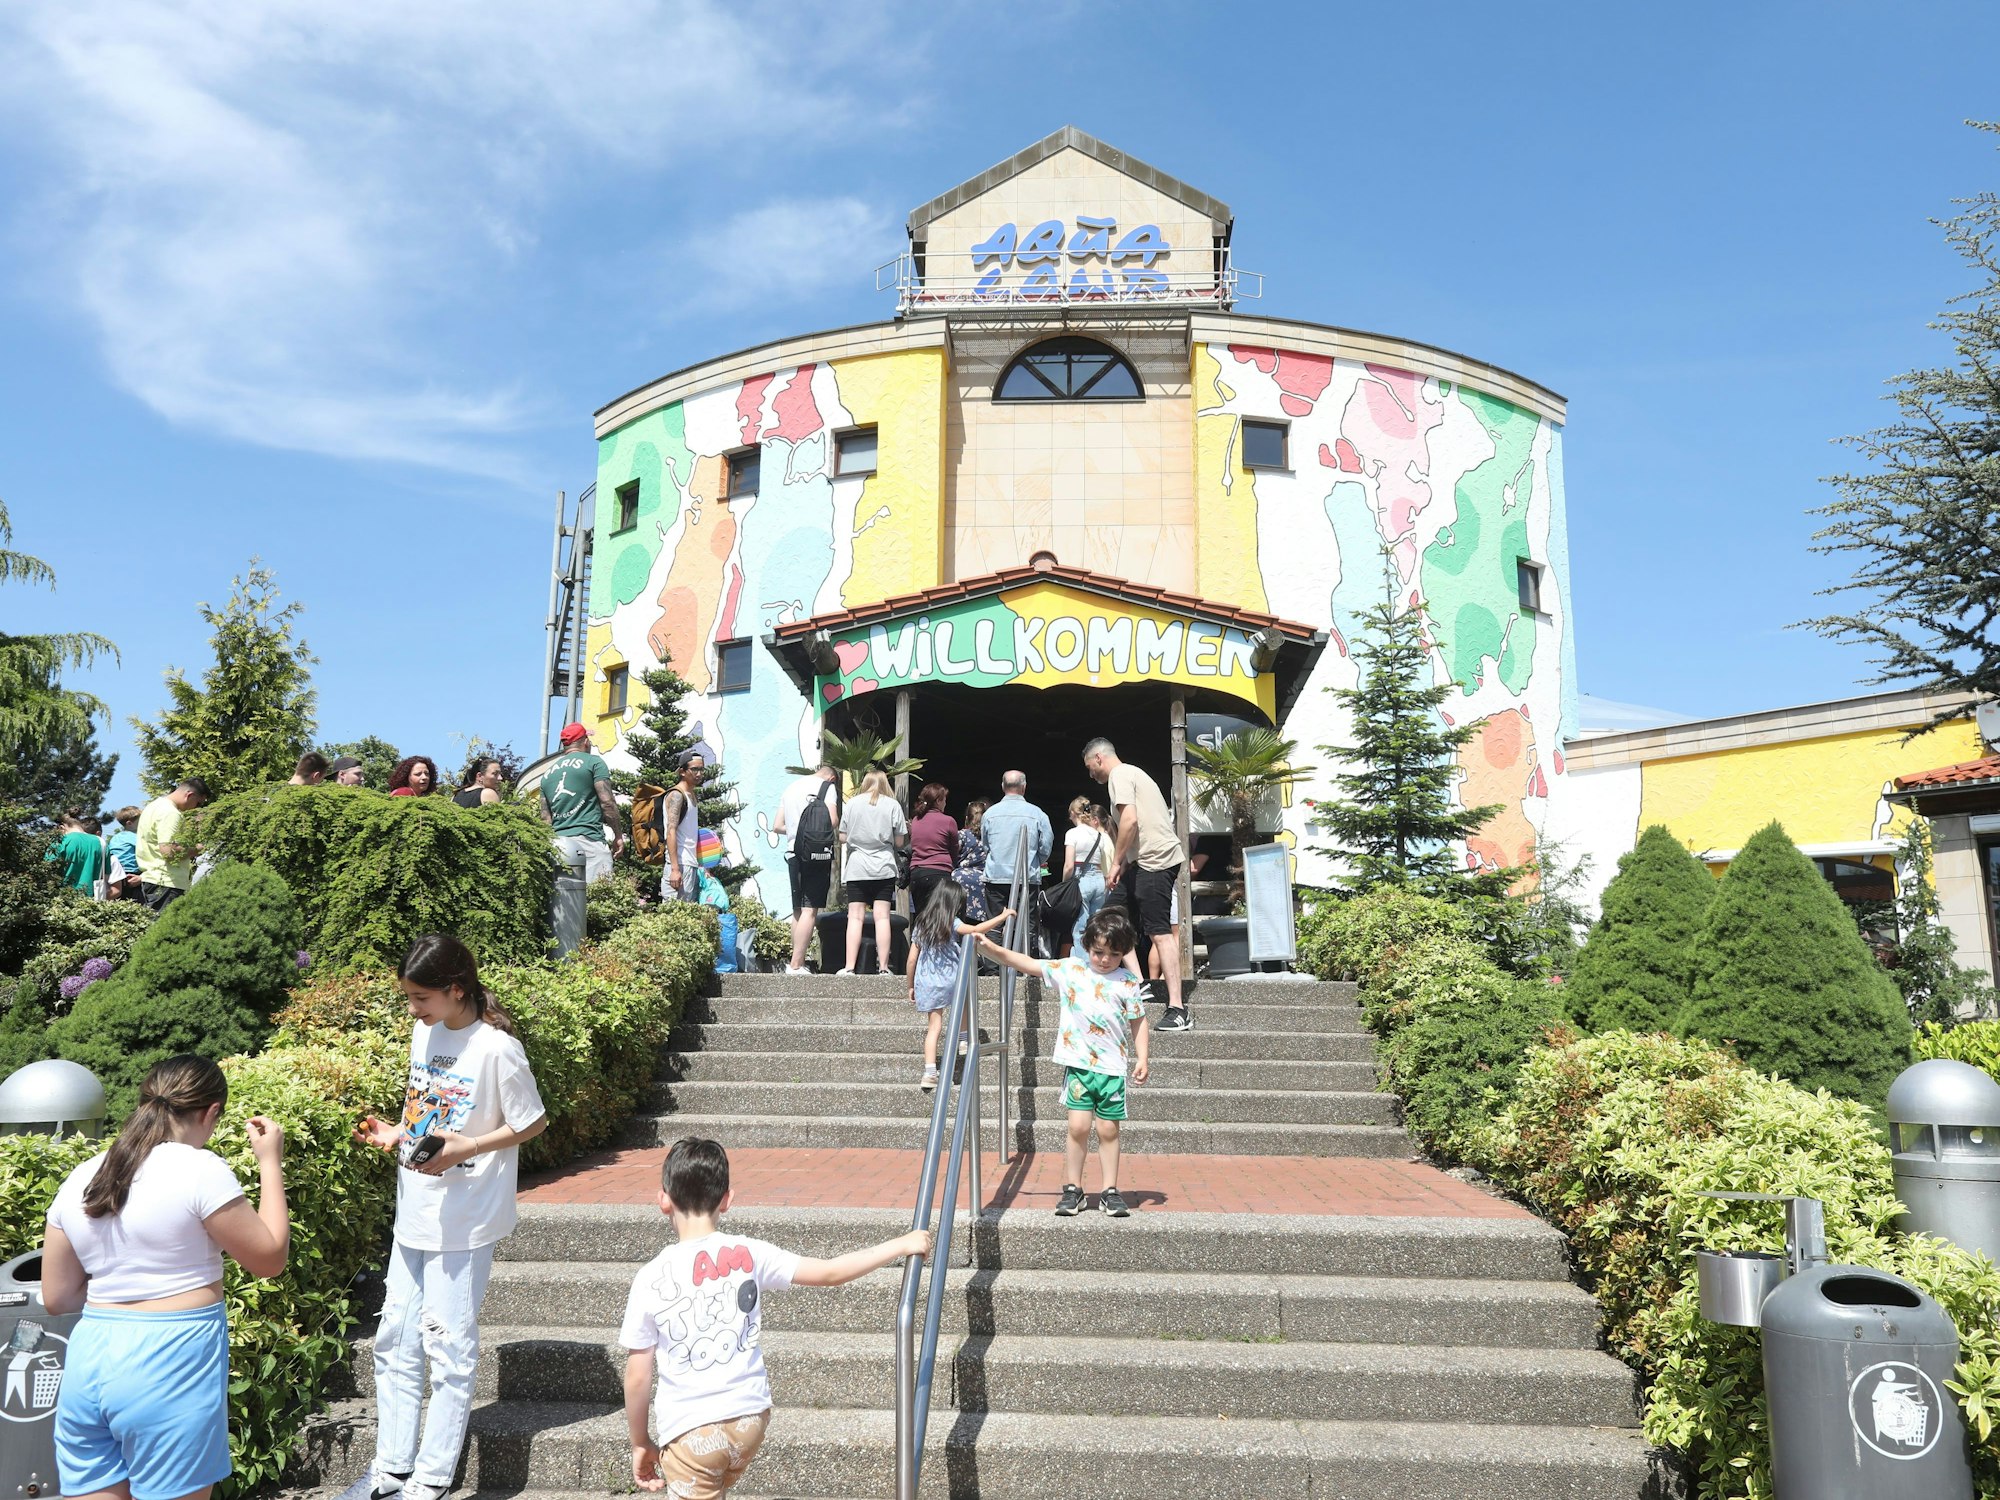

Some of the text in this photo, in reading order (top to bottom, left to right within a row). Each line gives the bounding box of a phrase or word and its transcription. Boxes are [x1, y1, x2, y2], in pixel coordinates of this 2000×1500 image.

[970, 215, 1171, 267] AQUA
[543, 757, 584, 779] PARIS
[810, 852, 831, 860] PUMA
[692, 1244, 754, 1287] AM
